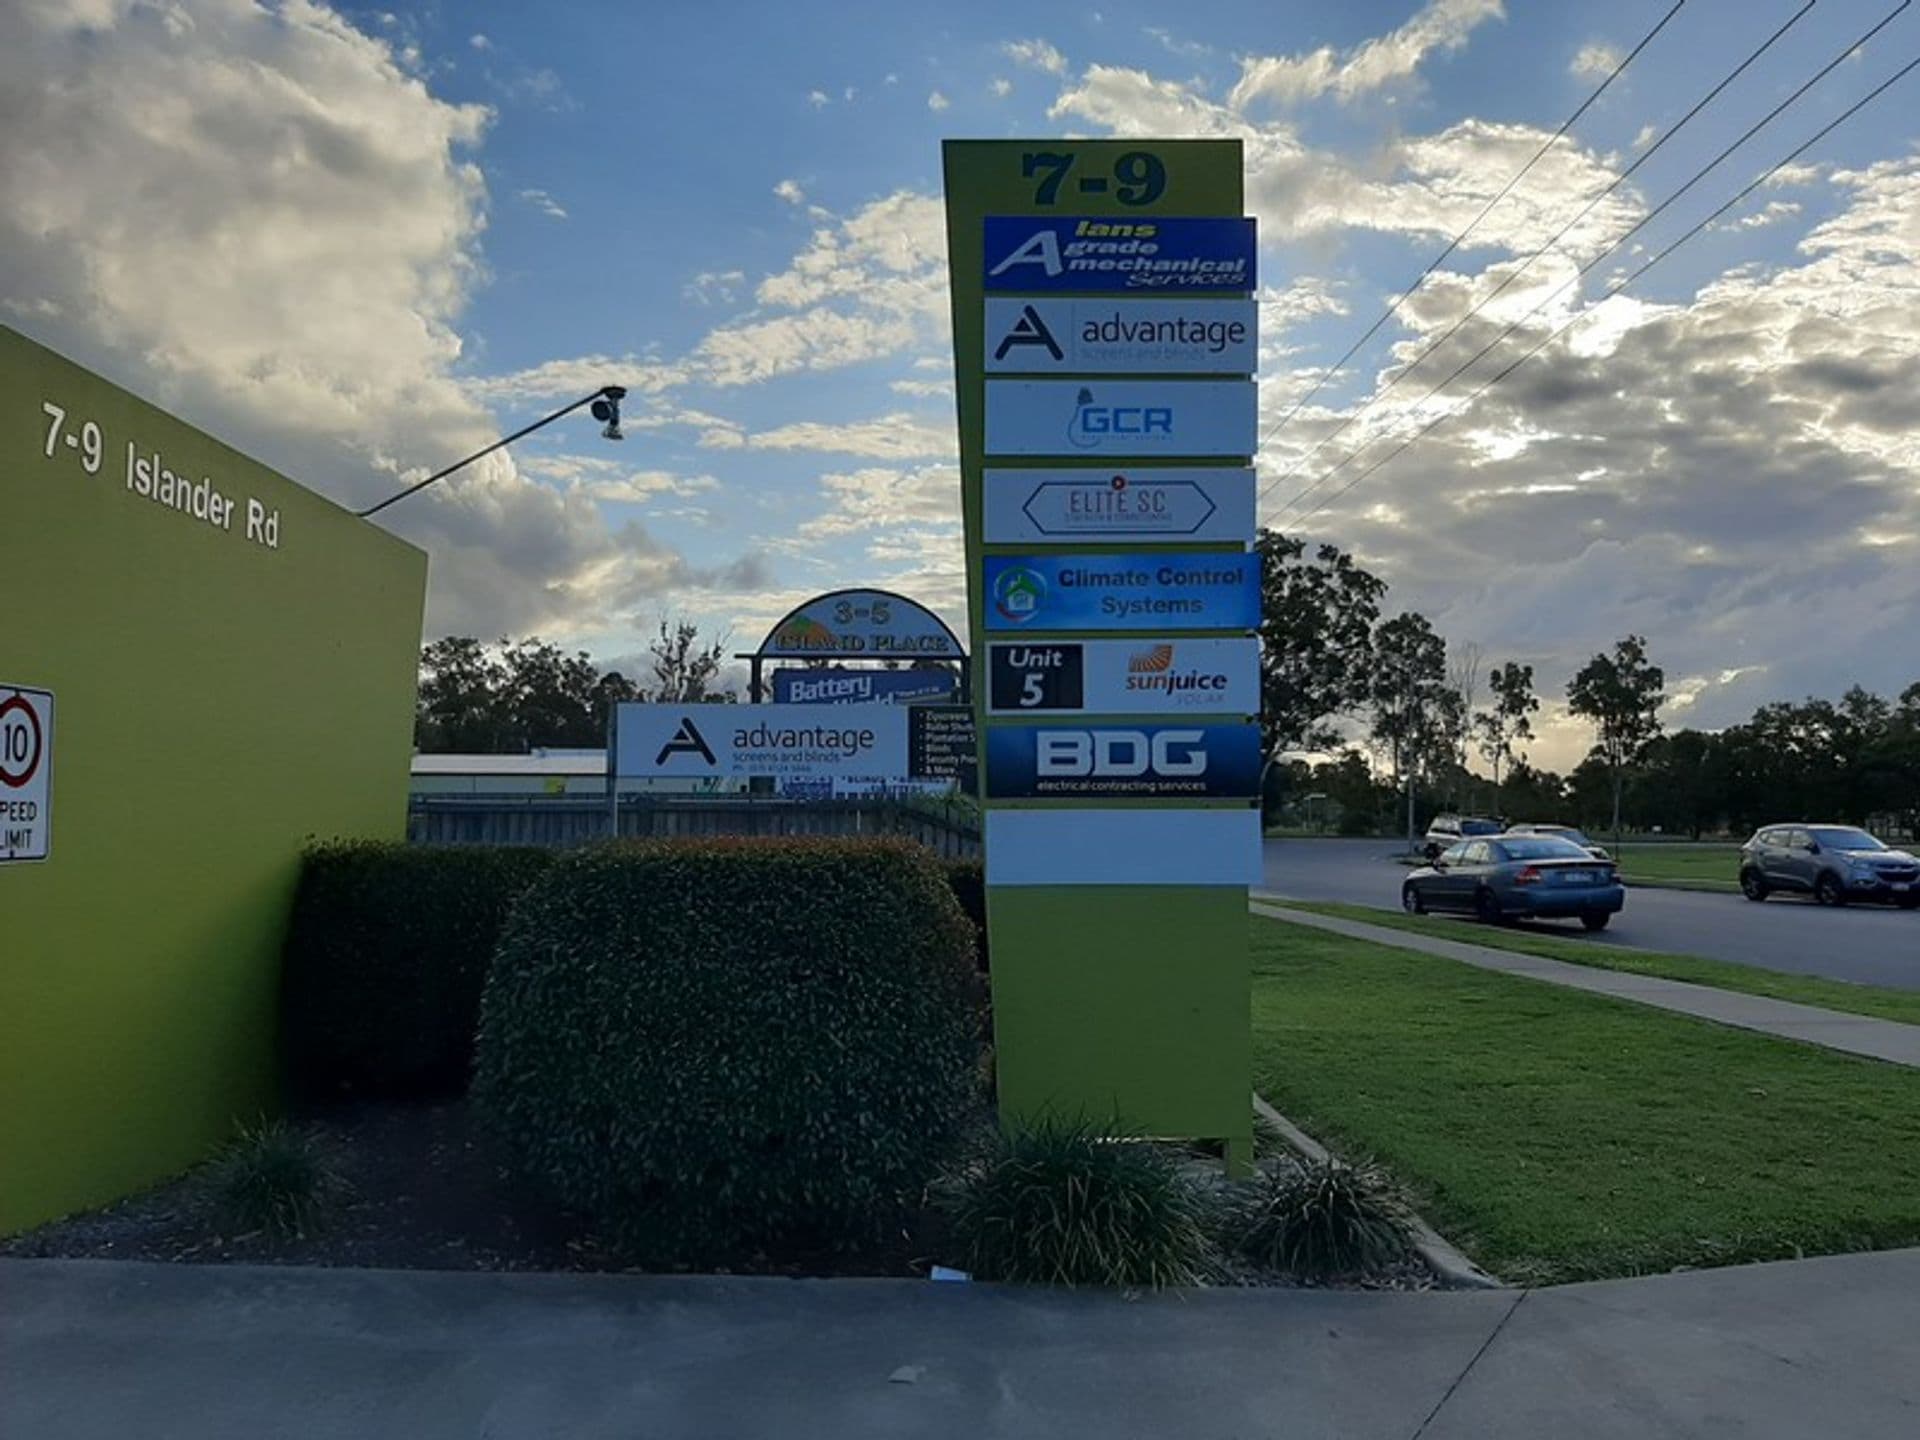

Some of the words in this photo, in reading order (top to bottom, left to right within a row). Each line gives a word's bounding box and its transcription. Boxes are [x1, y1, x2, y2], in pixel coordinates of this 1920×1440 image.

[1022, 151, 1167, 207] 7-9
[1063, 239, 1160, 258] grade
[1067, 257, 1247, 273] mechanical
[1124, 271, 1246, 288] Services
[1082, 312, 1246, 352] advantage
[1081, 407, 1174, 434] GCR
[42, 401, 104, 474] 7-9
[125, 440, 236, 530] Islander
[246, 497, 280, 549] Rd
[1069, 490, 1129, 514] ELITE
[1136, 490, 1166, 514] SC
[1058, 568, 1150, 588] Climate
[1155, 567, 1244, 587] Control
[833, 600, 892, 626] 3-5
[1101, 596, 1204, 619] Systems
[870, 633, 950, 652] PLACE
[1007, 648, 1064, 668] Unit
[789, 675, 872, 702] Battery
[1019, 672, 1044, 707] 5
[1125, 669, 1229, 696] sunjuice
[4, 723, 28, 763] 10
[732, 722, 876, 758] advantage
[1036, 729, 1208, 777] BDG
[1036, 780, 1089, 792] electrical
[1090, 780, 1156, 793] contracting
[1158, 780, 1208, 792] services
[0, 801, 37, 823] PEED
